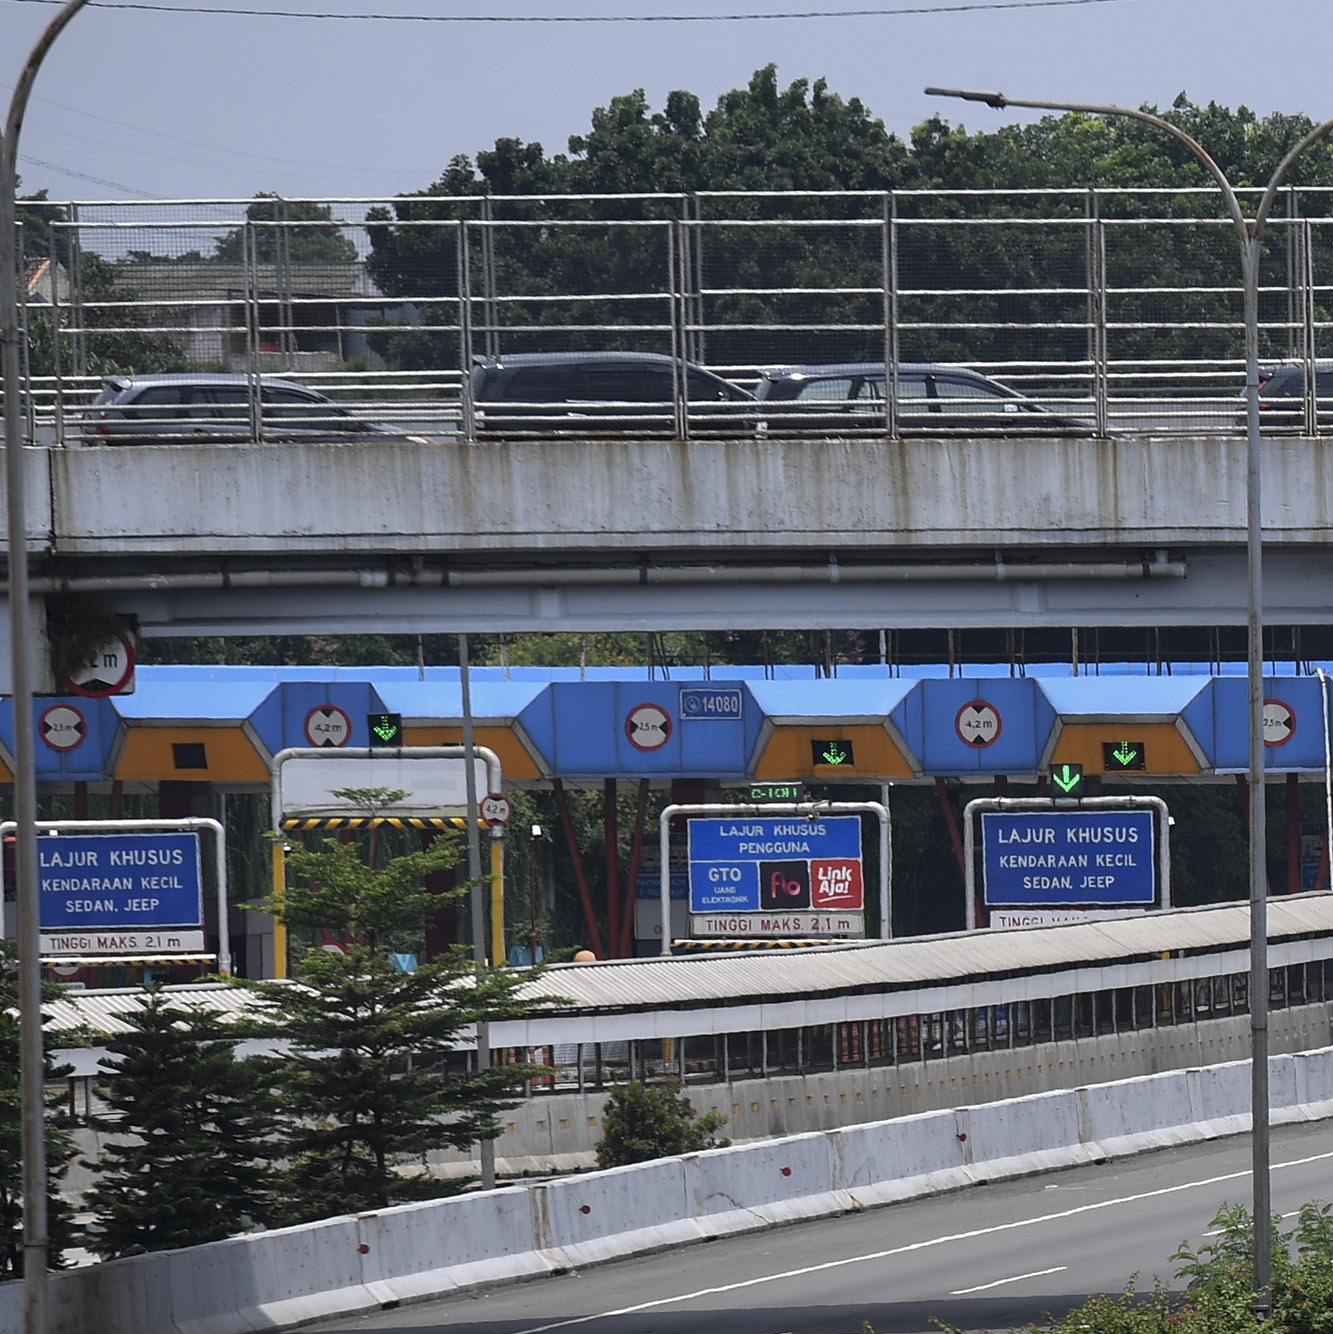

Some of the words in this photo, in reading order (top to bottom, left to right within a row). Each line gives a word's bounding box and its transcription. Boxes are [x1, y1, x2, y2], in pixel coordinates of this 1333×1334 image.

[702, 696, 738, 712] 14080
[720, 825, 763, 837] LAJUR
[774, 825, 826, 836] KHUSUS
[998, 828, 1055, 844] LAJUR
[1067, 827, 1139, 843] KHUSUS
[739, 842, 810, 854] PENGGUNA
[40, 851, 98, 868] LAJUR
[110, 849, 183, 866] KHUSUS
[1000, 855, 1088, 868] KENDARAAN
[1096, 853, 1137, 866] KECIL
[708, 868, 741, 881] GTO
[818, 866, 852, 880] Link
[42, 878, 133, 891] KENDARAAN
[141, 876, 183, 890] KECIL
[770, 871, 801, 898] flo
[819, 881, 849, 894] Aja!
[1080, 876, 1115, 889] JEEP
[124, 899, 160, 912] JEEP
[702, 896, 748, 904] ELEKTRONIK
[707, 919, 751, 931] TINGGI
[838, 919, 850, 929] m
[50, 936, 91, 949] TINGGI
[167, 938, 180, 947] m
